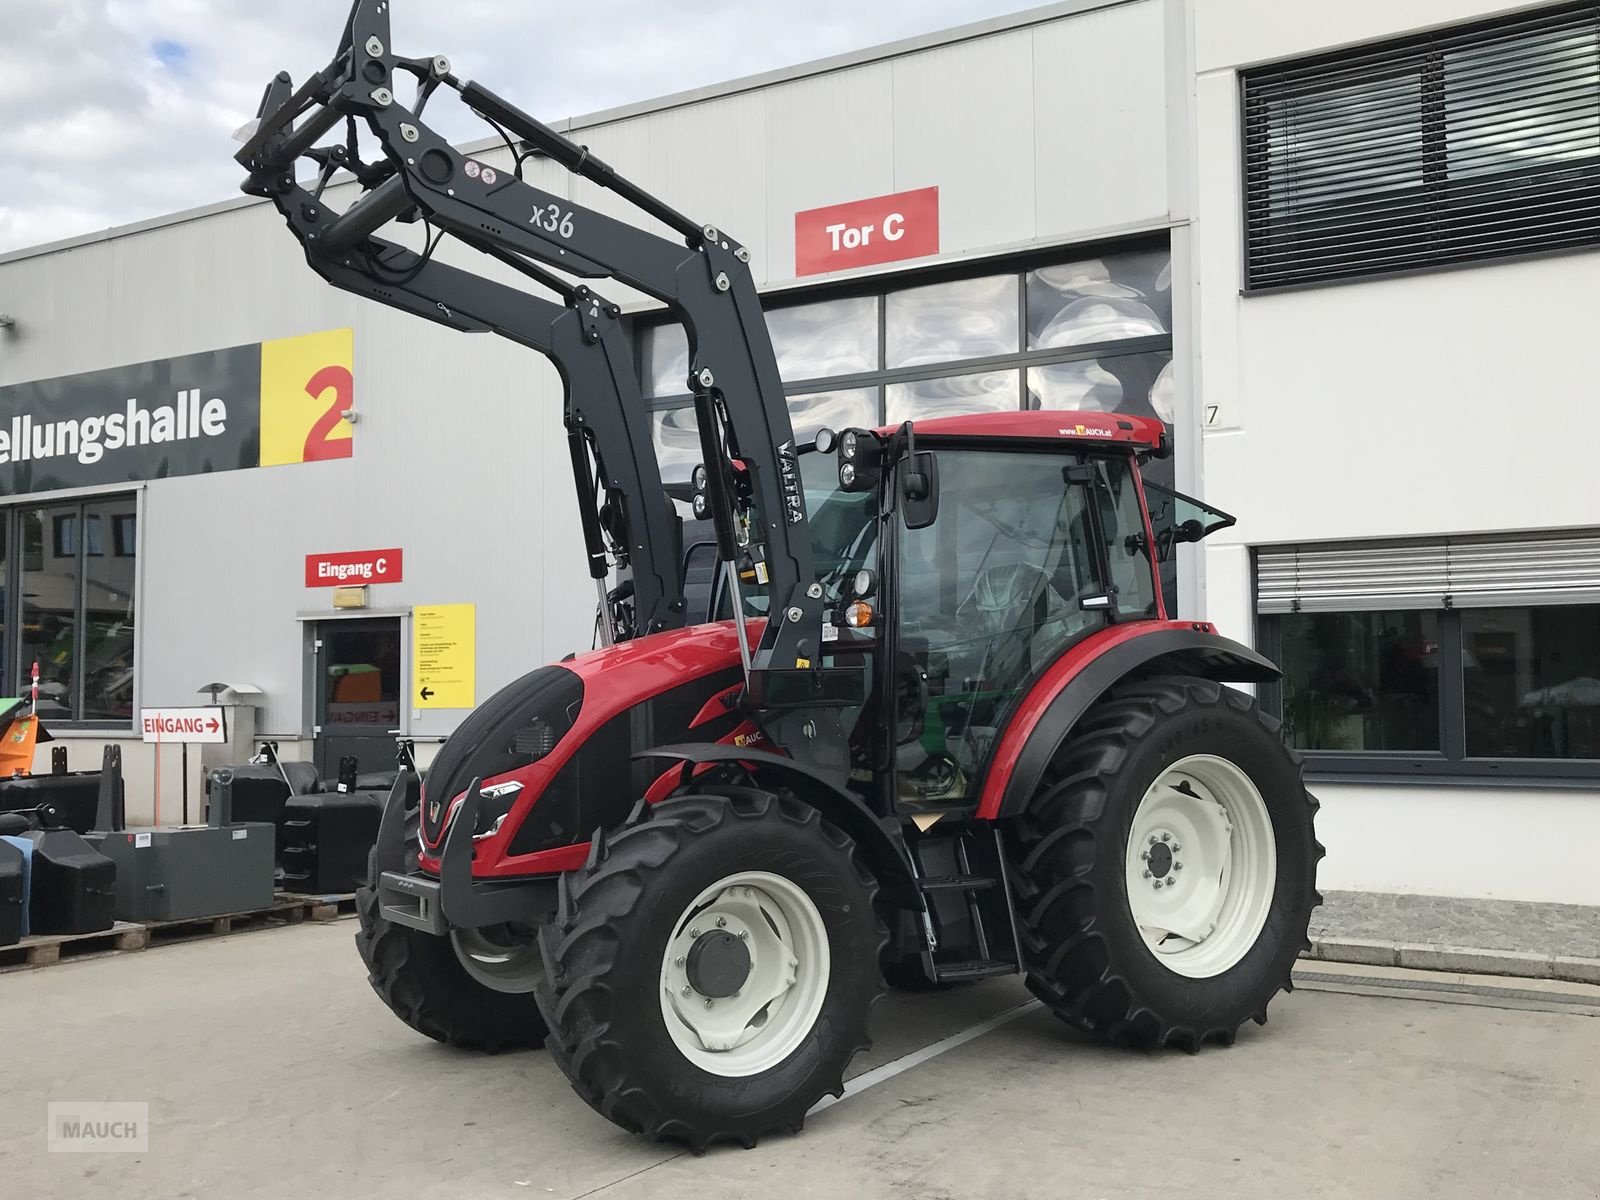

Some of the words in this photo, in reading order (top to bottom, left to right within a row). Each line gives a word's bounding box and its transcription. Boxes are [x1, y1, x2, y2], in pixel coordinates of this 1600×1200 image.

[529, 204, 574, 239] x36
[826, 223, 874, 251] Tor
[883, 213, 905, 241] C
[303, 365, 353, 462] 2
[1207, 405, 1218, 424] 7
[778, 440, 803, 523] VALTRA
[318, 562, 373, 580] Eingang
[376, 558, 387, 574] C
[144, 718, 204, 733] EINGANG
